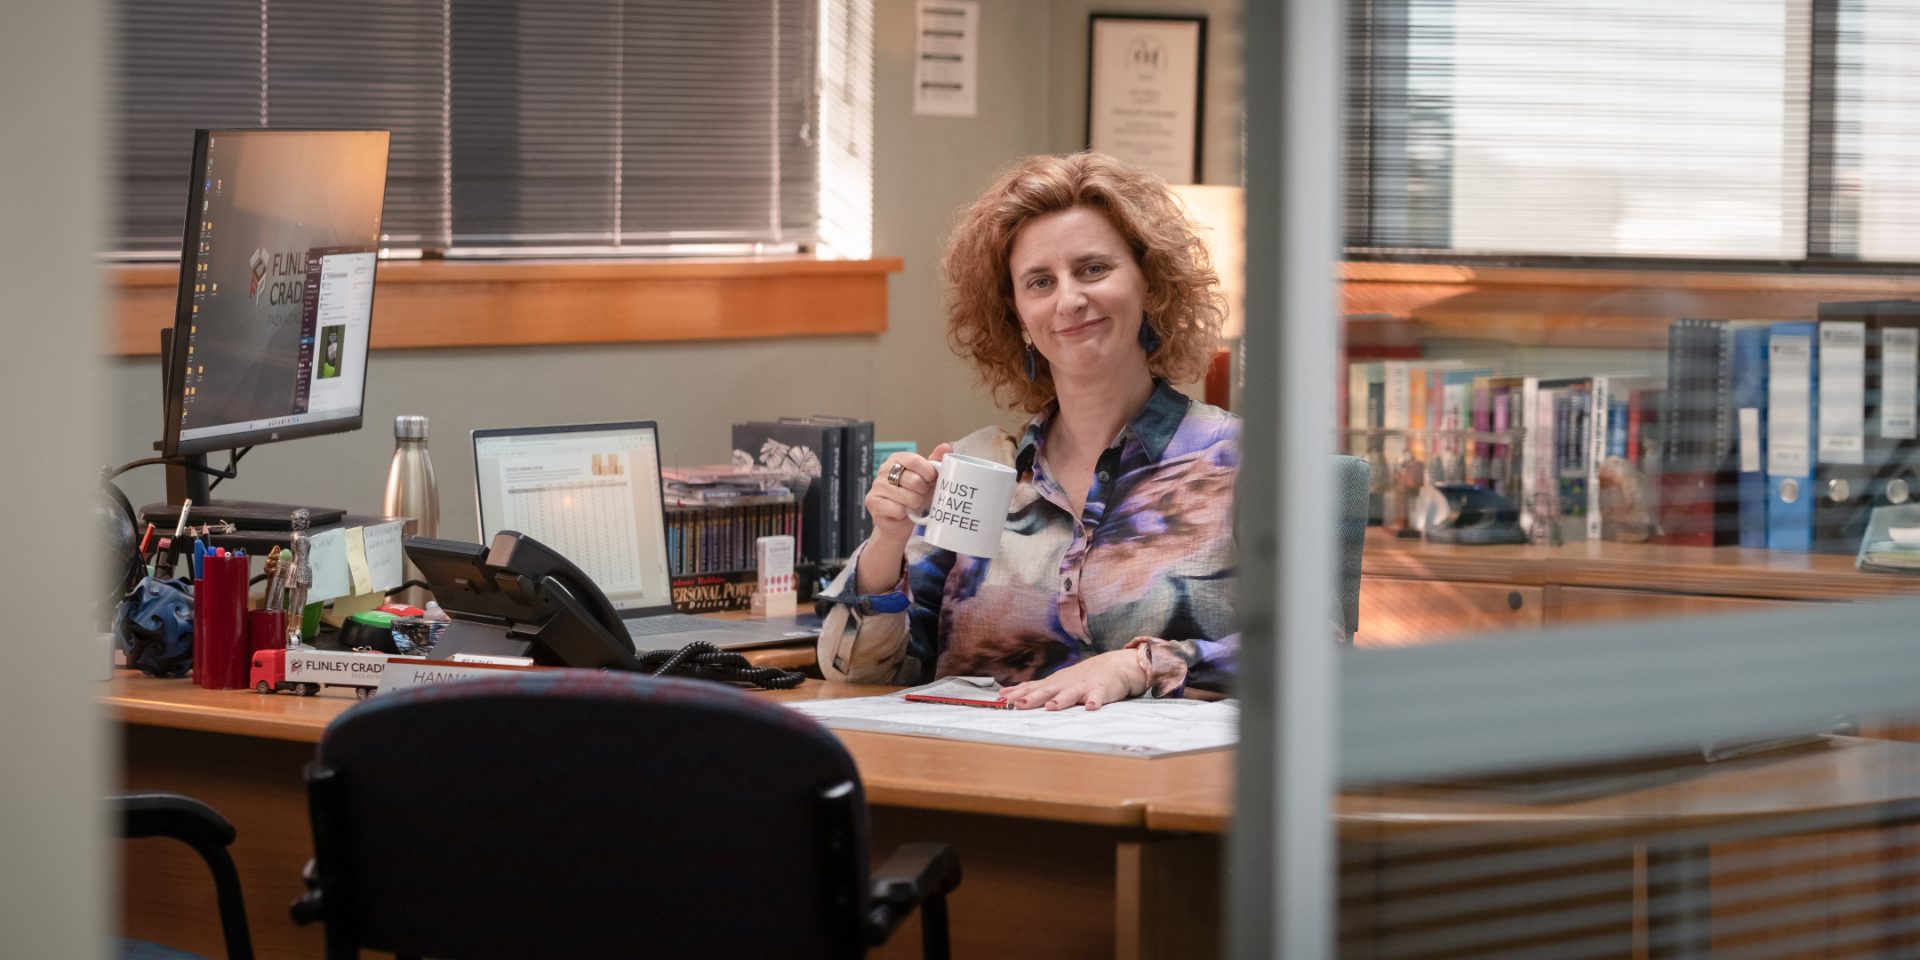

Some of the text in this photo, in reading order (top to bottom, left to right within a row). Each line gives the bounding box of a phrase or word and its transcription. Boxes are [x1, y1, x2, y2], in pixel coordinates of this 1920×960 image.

[270, 281, 304, 305] CRAD
[940, 478, 979, 499] MUST
[937, 494, 973, 514] HAVE
[930, 506, 981, 532] COFFEE
[672, 585, 721, 603] ERSONAL
[306, 660, 350, 671] FLINLEY
